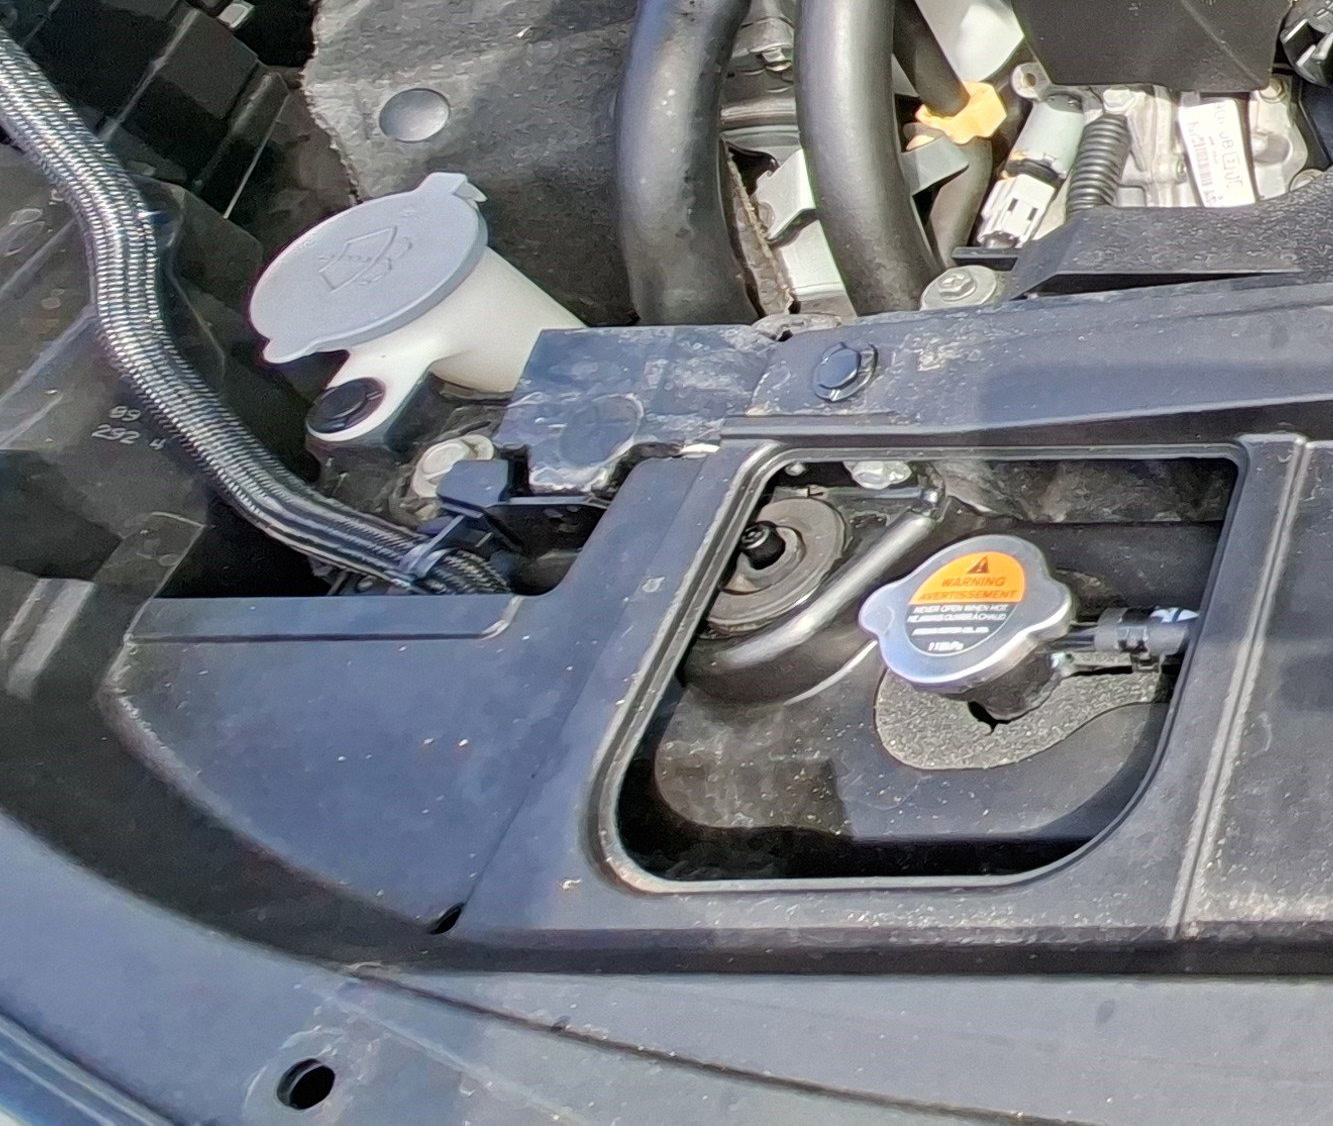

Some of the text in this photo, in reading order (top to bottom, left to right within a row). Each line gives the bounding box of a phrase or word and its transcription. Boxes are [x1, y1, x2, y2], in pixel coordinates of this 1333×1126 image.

[941, 577, 1007, 587] WARNING
[918, 590, 1019, 601] AVERTISSEMENT
[941, 604, 963, 612] OPEN
